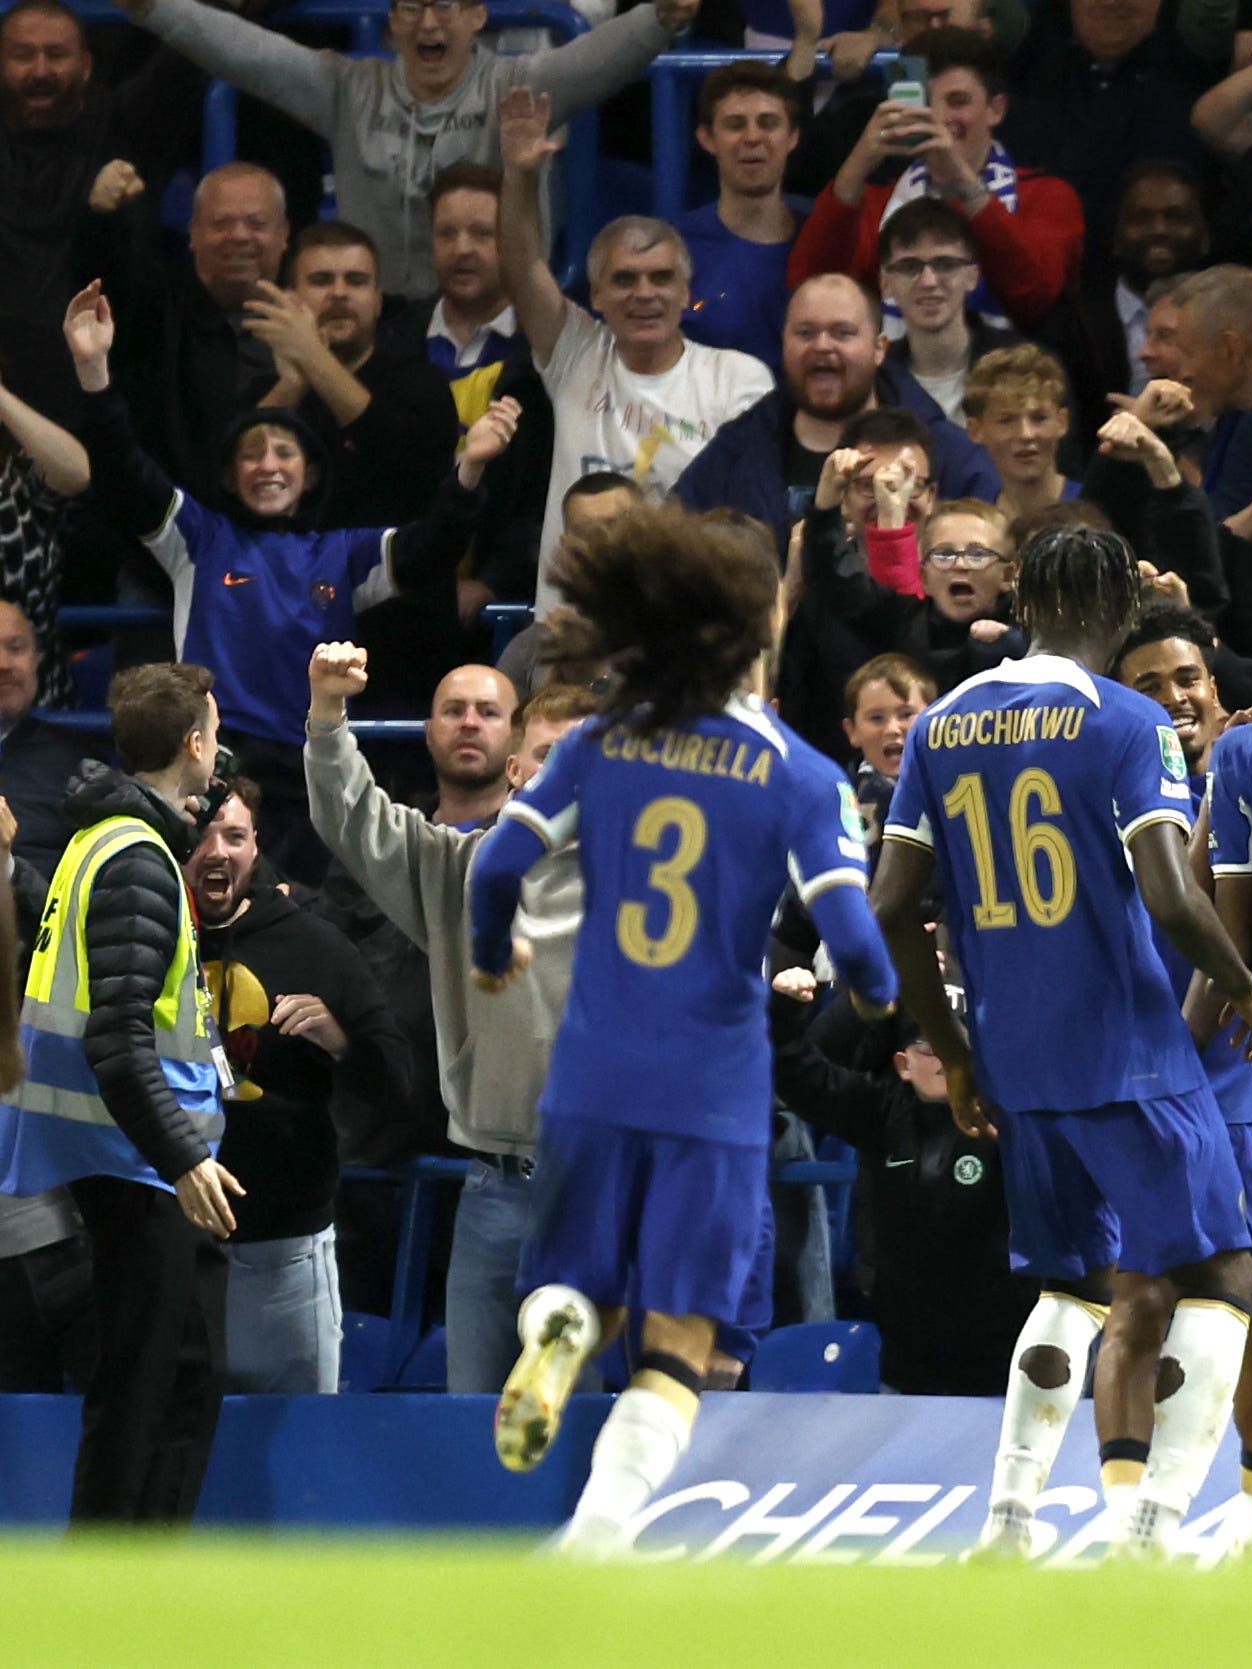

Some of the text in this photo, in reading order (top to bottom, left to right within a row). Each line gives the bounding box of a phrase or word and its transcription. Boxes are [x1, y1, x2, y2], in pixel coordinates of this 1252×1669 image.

[928, 706, 1085, 750] UGOCHUKWU
[616, 795, 708, 968] 3
[942, 767, 1077, 930] 16
